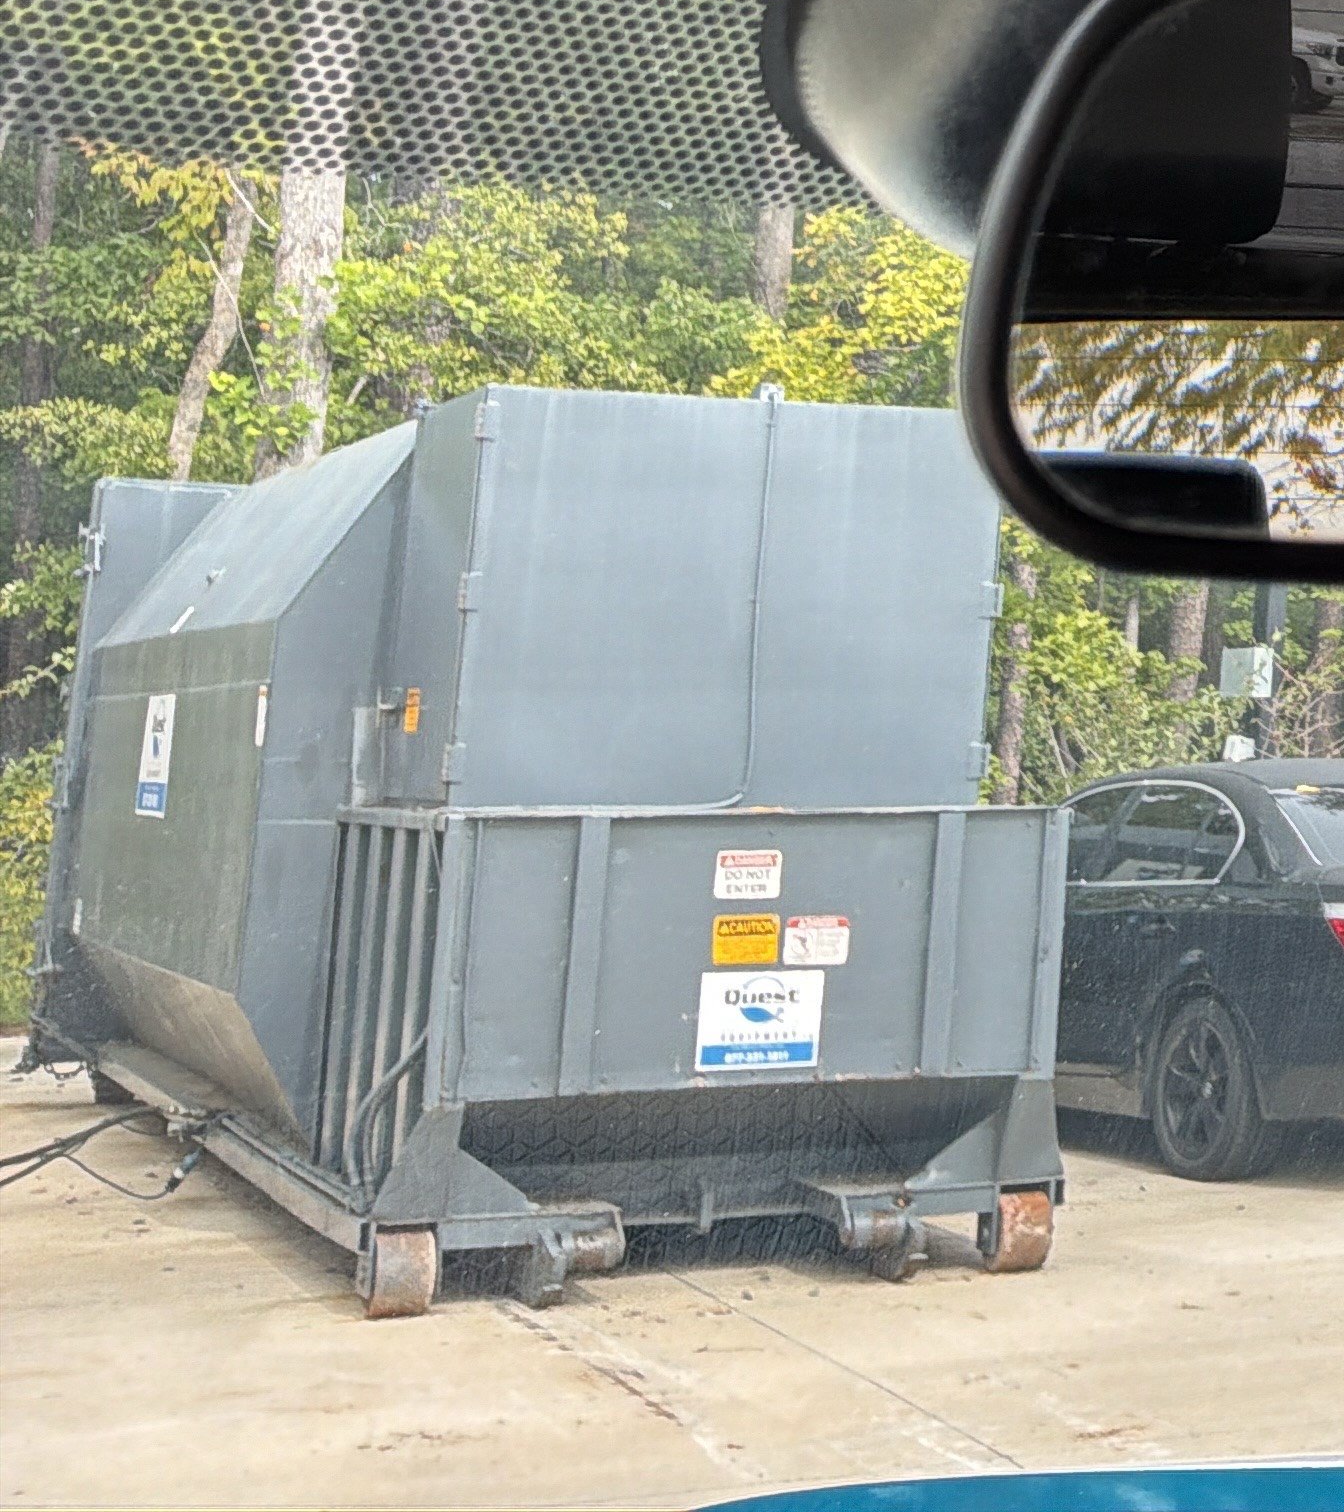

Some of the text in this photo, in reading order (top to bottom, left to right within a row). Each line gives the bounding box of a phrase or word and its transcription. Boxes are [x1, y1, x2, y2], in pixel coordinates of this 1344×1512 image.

[725, 869, 771, 880] DO NOT
[726, 884, 767, 894] ENTER
[729, 920, 775, 935] CAUTION
[724, 989, 800, 1005] Quest
